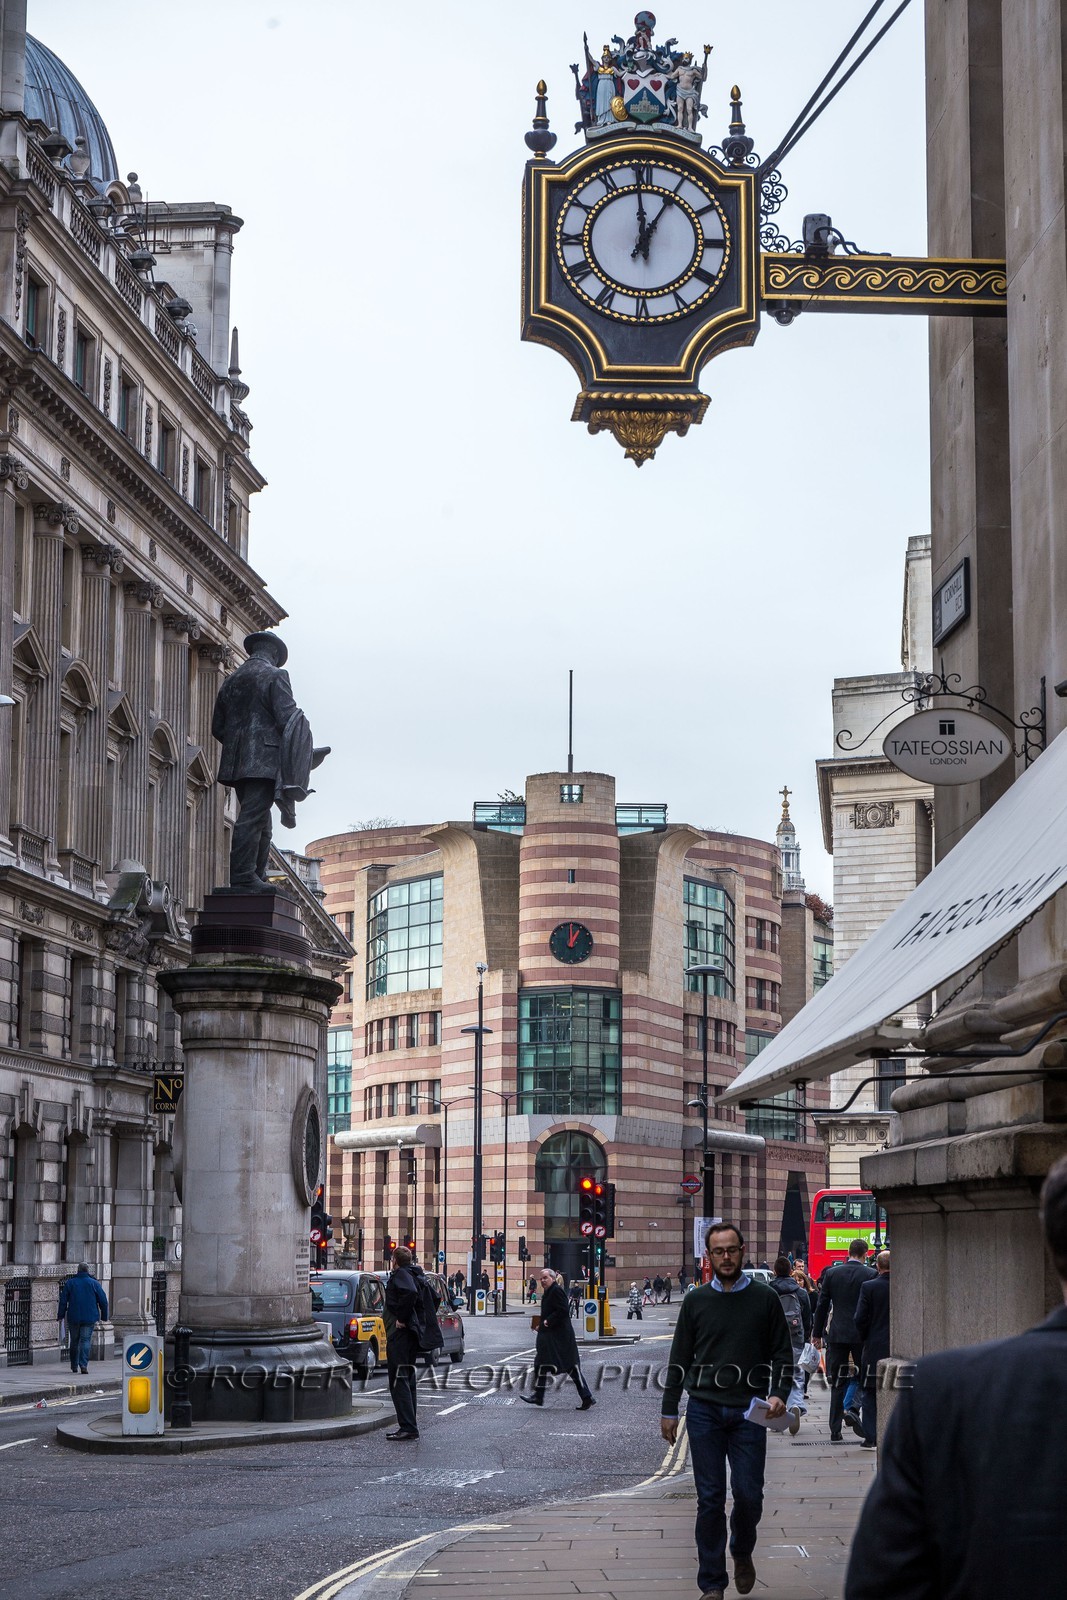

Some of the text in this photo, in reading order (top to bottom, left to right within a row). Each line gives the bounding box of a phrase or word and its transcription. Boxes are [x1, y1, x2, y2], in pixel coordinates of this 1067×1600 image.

[891, 740, 1003, 755] TATEOSSIAN
[929, 757, 967, 765] LONDON
[155, 1102, 177, 1111] CORN
